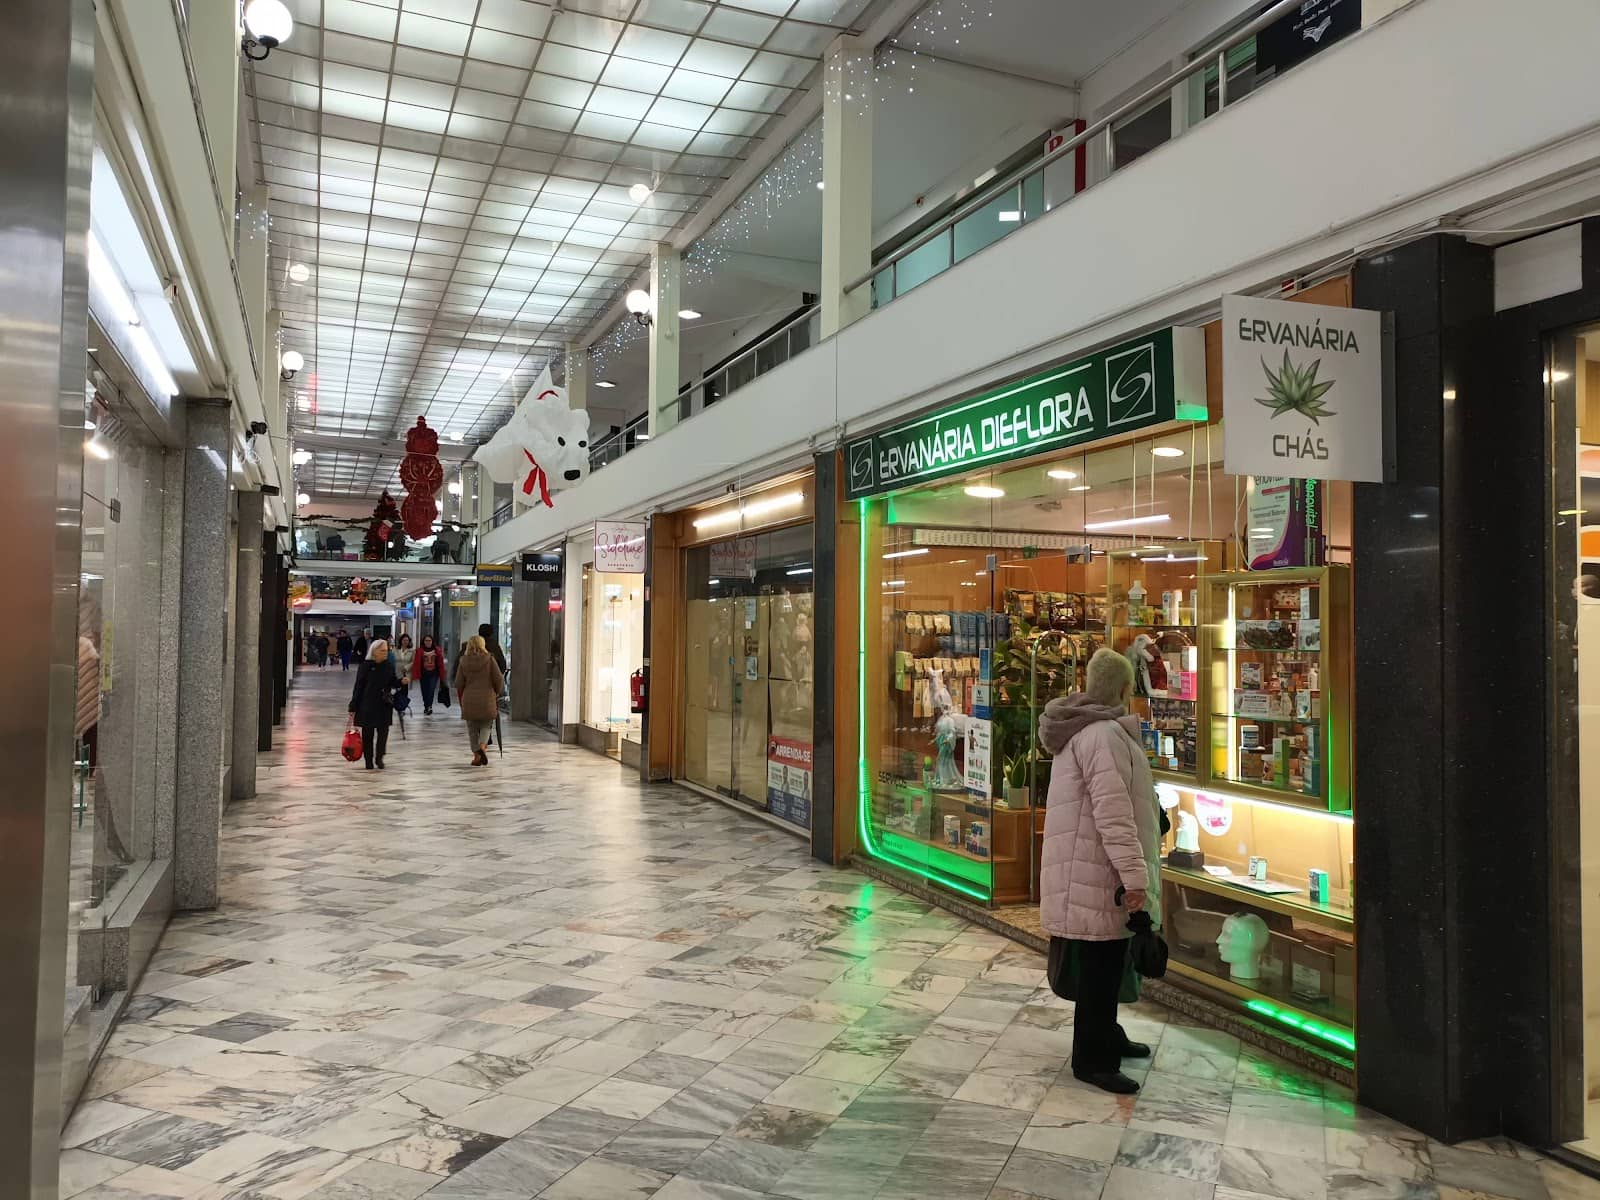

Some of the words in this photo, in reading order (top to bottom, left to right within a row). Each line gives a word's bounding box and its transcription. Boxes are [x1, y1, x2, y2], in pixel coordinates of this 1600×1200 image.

[1239, 318, 1360, 353] ERVANÁRIA
[879, 420, 977, 478] ERVANÁRIA
[981, 386, 1095, 452] DIEFLORA
[1273, 428, 1329, 460] CHÁS
[526, 563, 559, 573] KLOSHI
